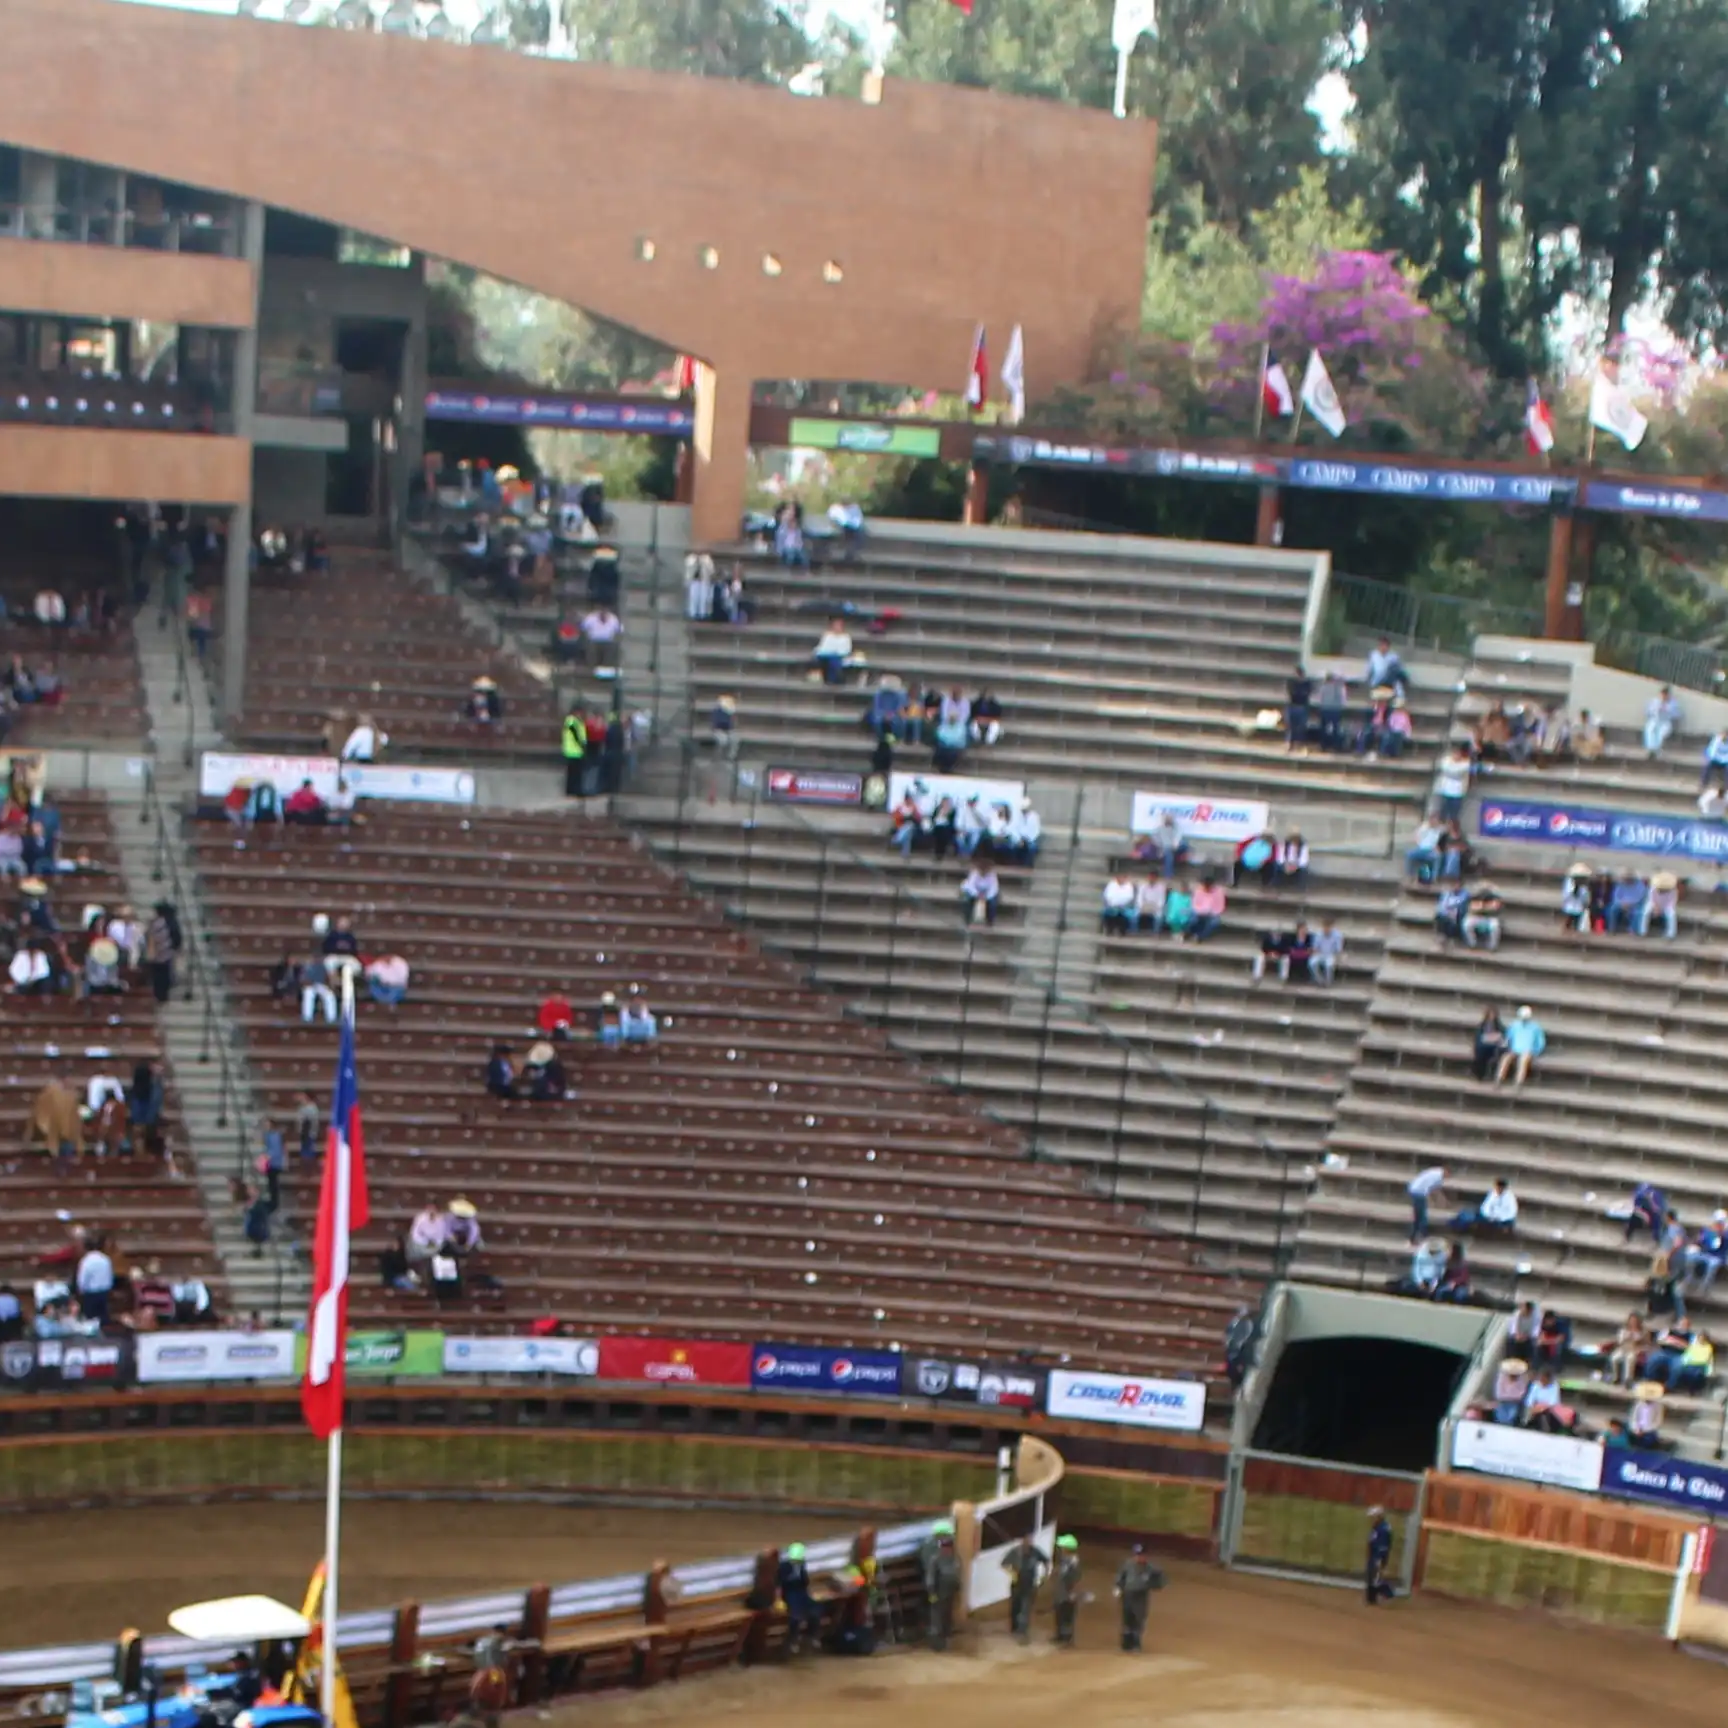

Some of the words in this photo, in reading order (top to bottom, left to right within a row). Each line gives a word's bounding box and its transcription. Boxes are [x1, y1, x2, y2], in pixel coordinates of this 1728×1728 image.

[1299, 462, 1357, 484] CAMPO
[1371, 467, 1429, 489] CAMPO
[1437, 473, 1495, 494] CAMPO
[1612, 821, 1673, 846] CAMPO
[1620, 1460, 1669, 1488] Banco
[1671, 1474, 1686, 1492] de
[1687, 1476, 1726, 1501] Chile
